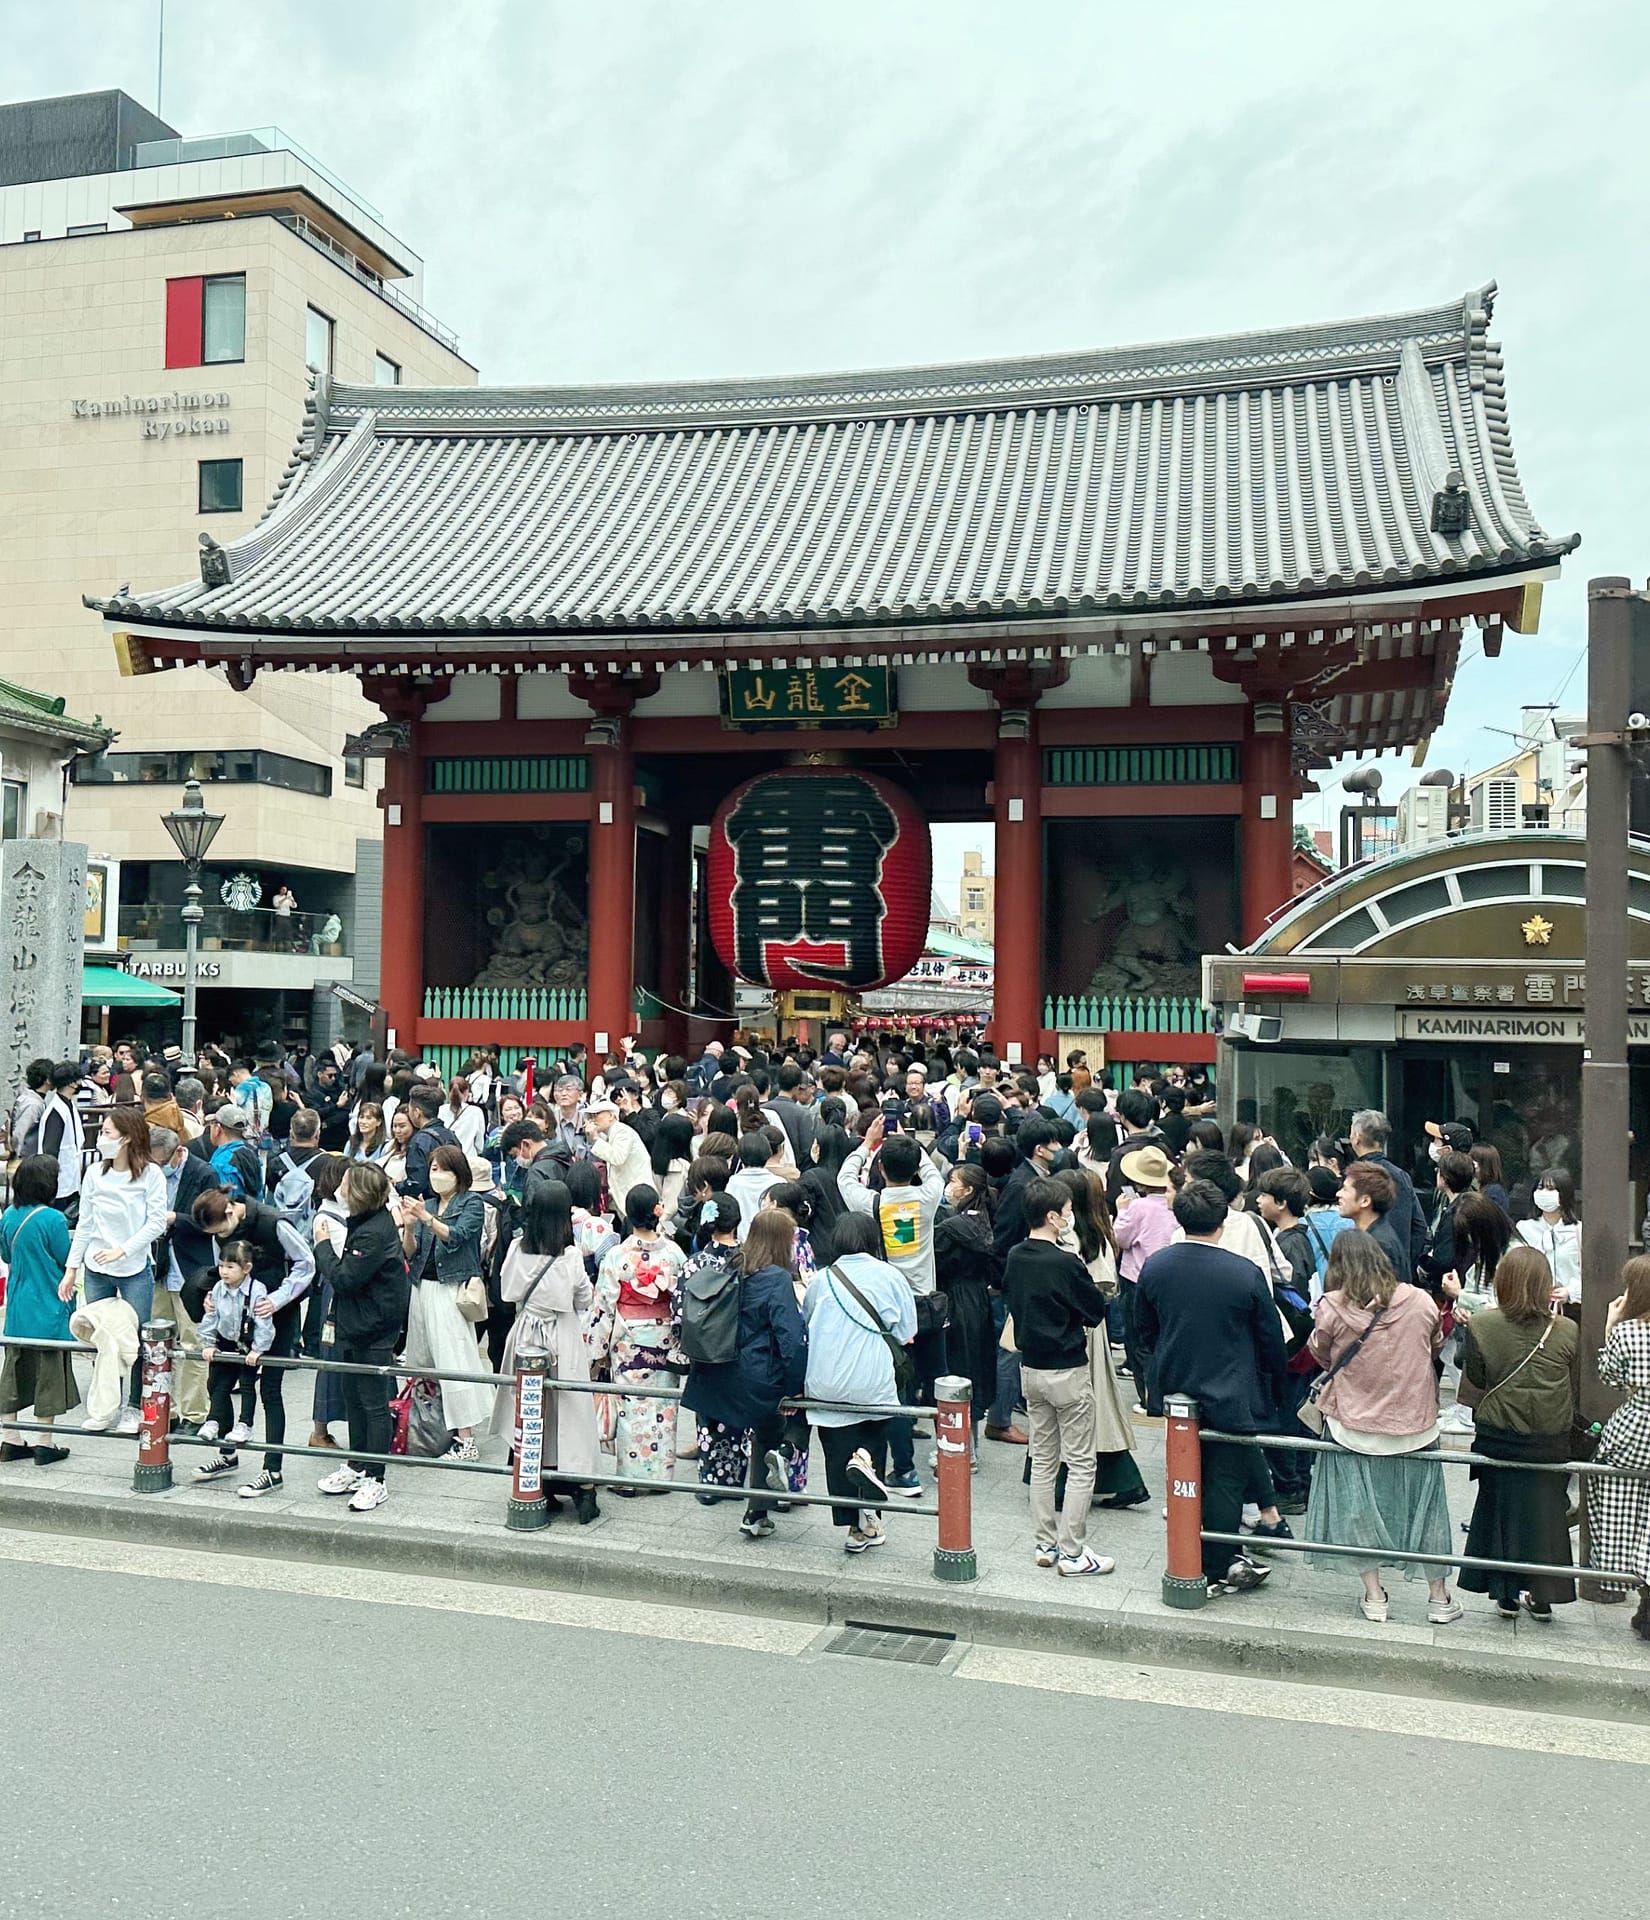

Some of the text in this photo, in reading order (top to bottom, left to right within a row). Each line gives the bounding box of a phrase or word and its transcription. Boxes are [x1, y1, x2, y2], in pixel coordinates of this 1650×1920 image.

[70, 391, 230, 418] Kaminarimon
[140, 416, 229, 440] Ryokan
[724, 773, 900, 988] 雷門
[118, 962, 220, 976] TARBUKS
[1406, 984, 1515, 1002] 浅草警察署
[1417, 1018, 1565, 1037] KAMINARIMON
[1173, 1480, 1197, 1498] 24K
